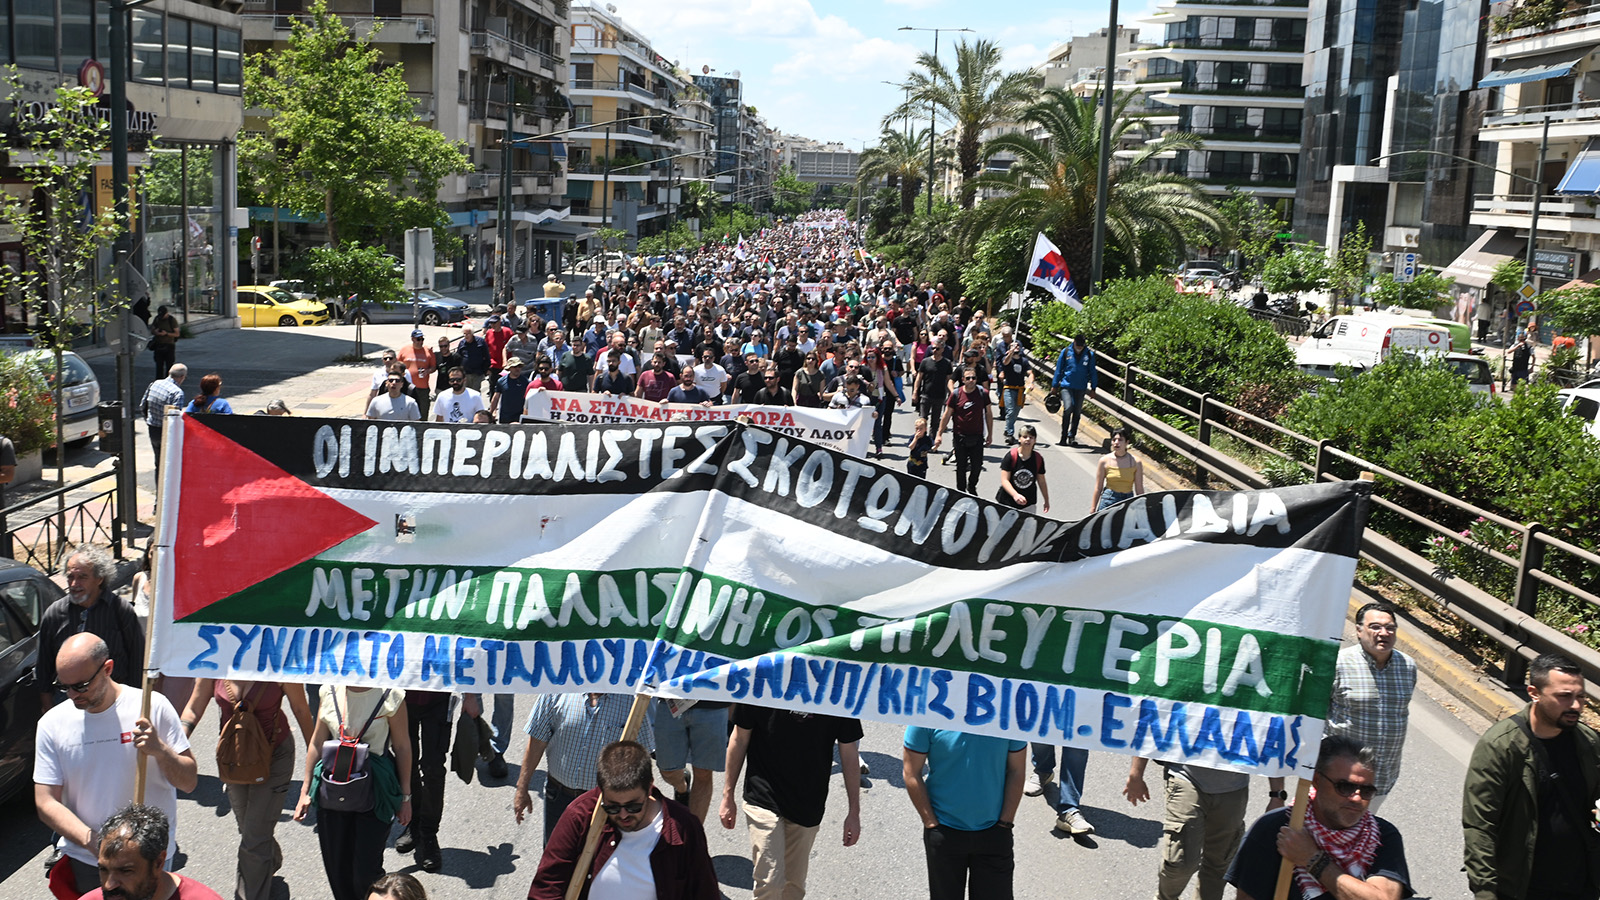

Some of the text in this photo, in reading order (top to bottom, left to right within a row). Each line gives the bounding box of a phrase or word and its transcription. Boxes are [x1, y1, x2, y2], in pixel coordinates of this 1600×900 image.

[550, 397, 582, 413] ΝΑ
[550, 411, 561, 420] Η
[810, 429, 855, 440] ΛΑΟΥ
[313, 424, 352, 479] ΟΙ
[363, 424, 728, 482] ΙΜΠΕΡΙΑΛΙΣΤΕΣ
[1078, 492, 1291, 550] ΠΑΙΔΙΑ
[305, 567, 375, 621] ΜΕ
[383, 568, 473, 621] ΤΗΝ
[931, 601, 1273, 698] ΛΕΥΤΕΡΙΑ
[188, 625, 404, 681] ΣΥΝΔΙΚΑΤΟ
[753, 653, 954, 720] ΝΑΥΠ/ΚΗΣ
[964, 673, 1093, 740] ΒΙΟΜ.
[1100, 692, 1303, 770] ΕΛΛΑΔΑΣ
